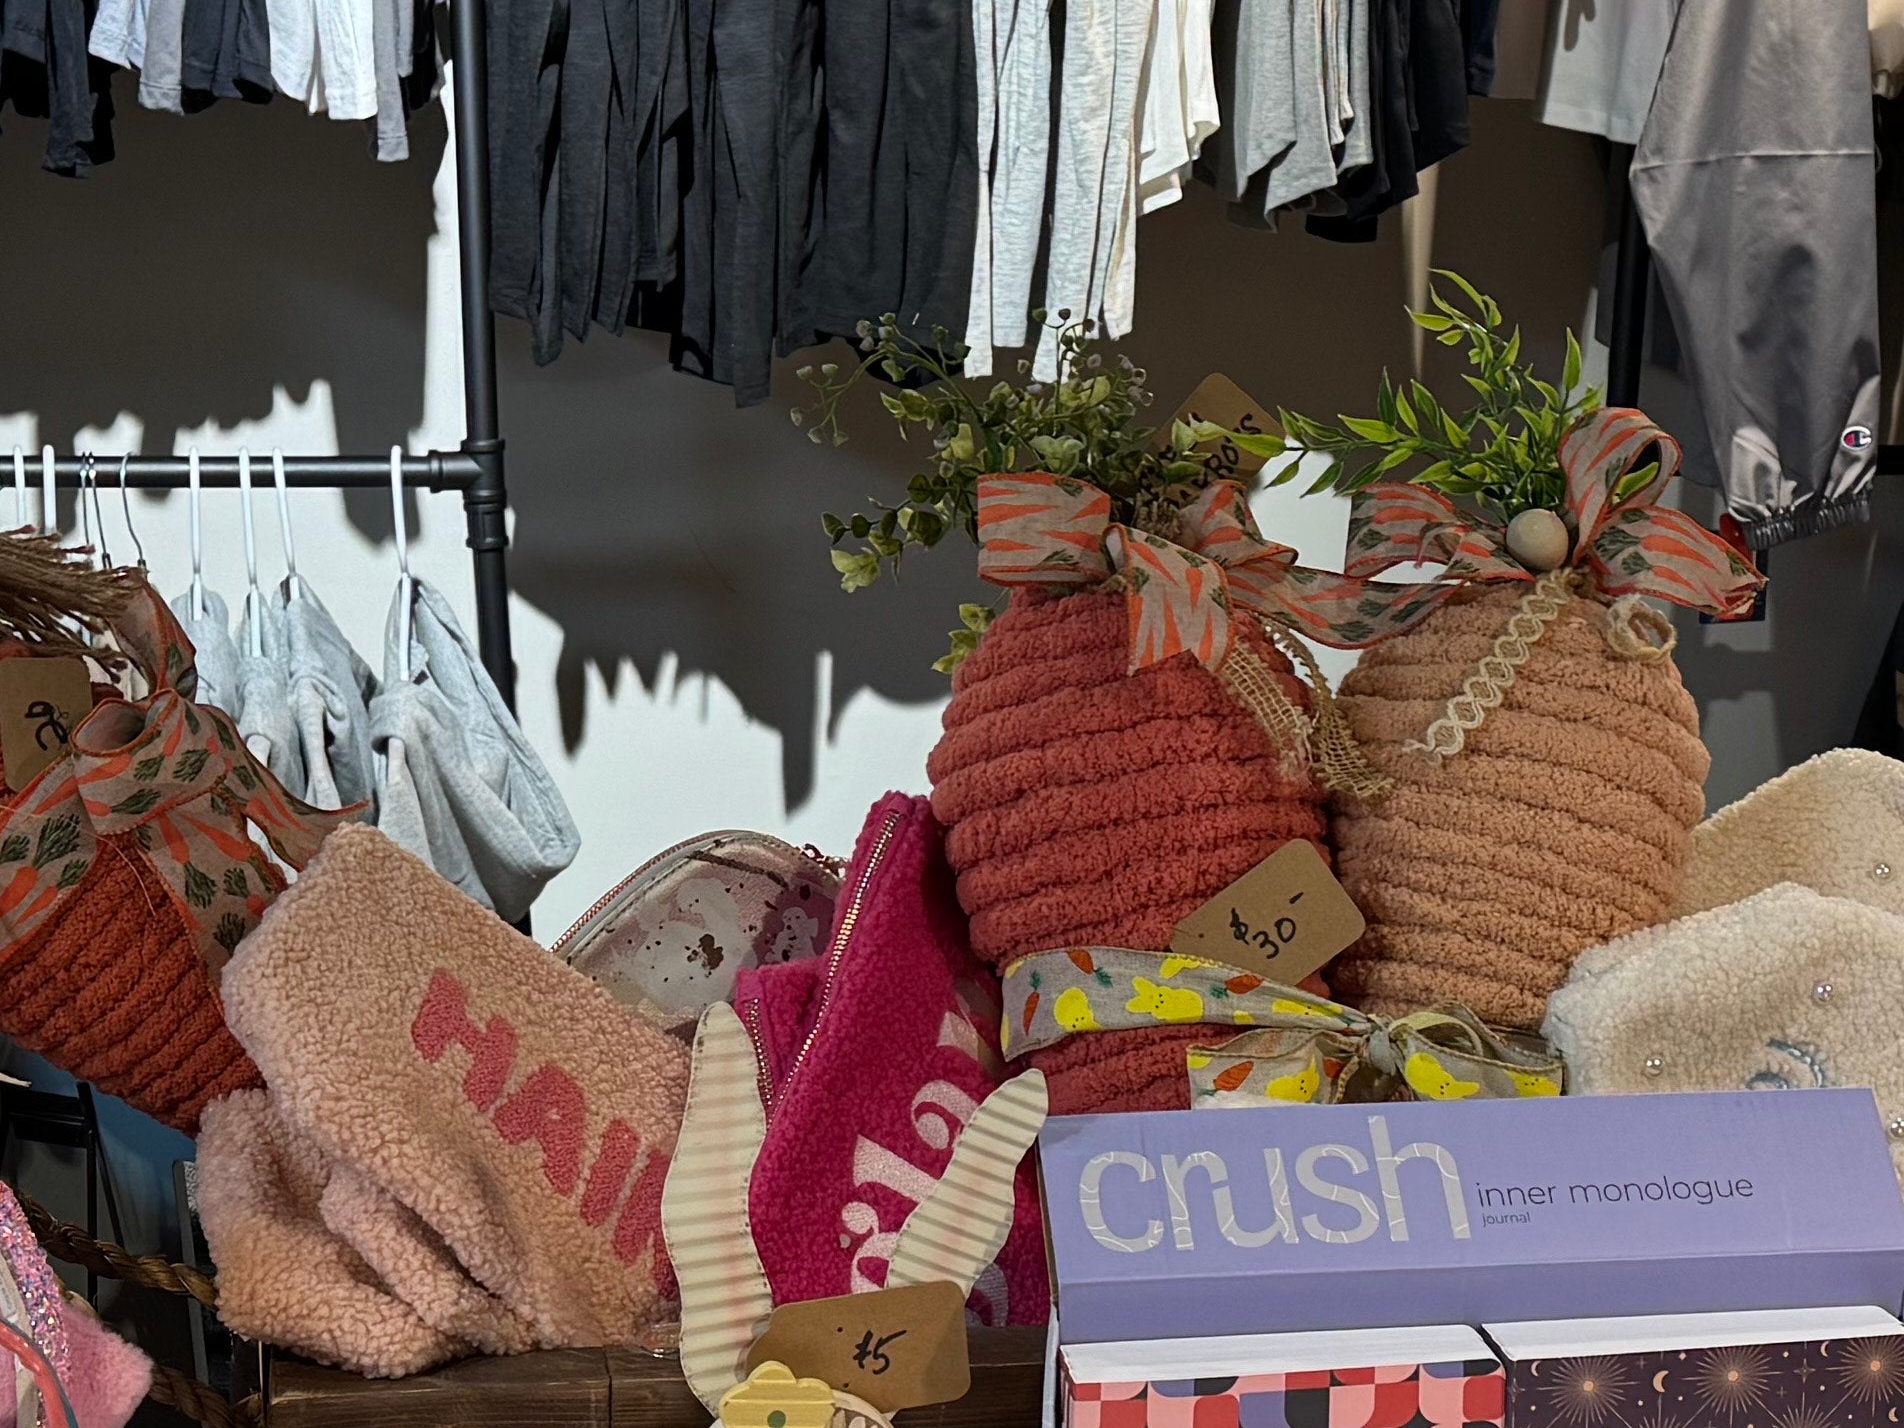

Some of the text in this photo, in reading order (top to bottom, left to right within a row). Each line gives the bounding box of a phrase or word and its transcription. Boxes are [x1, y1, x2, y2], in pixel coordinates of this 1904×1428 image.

[1080, 1116, 1755, 1253] crush inner monologue
[1481, 1210, 1532, 1227] journal
